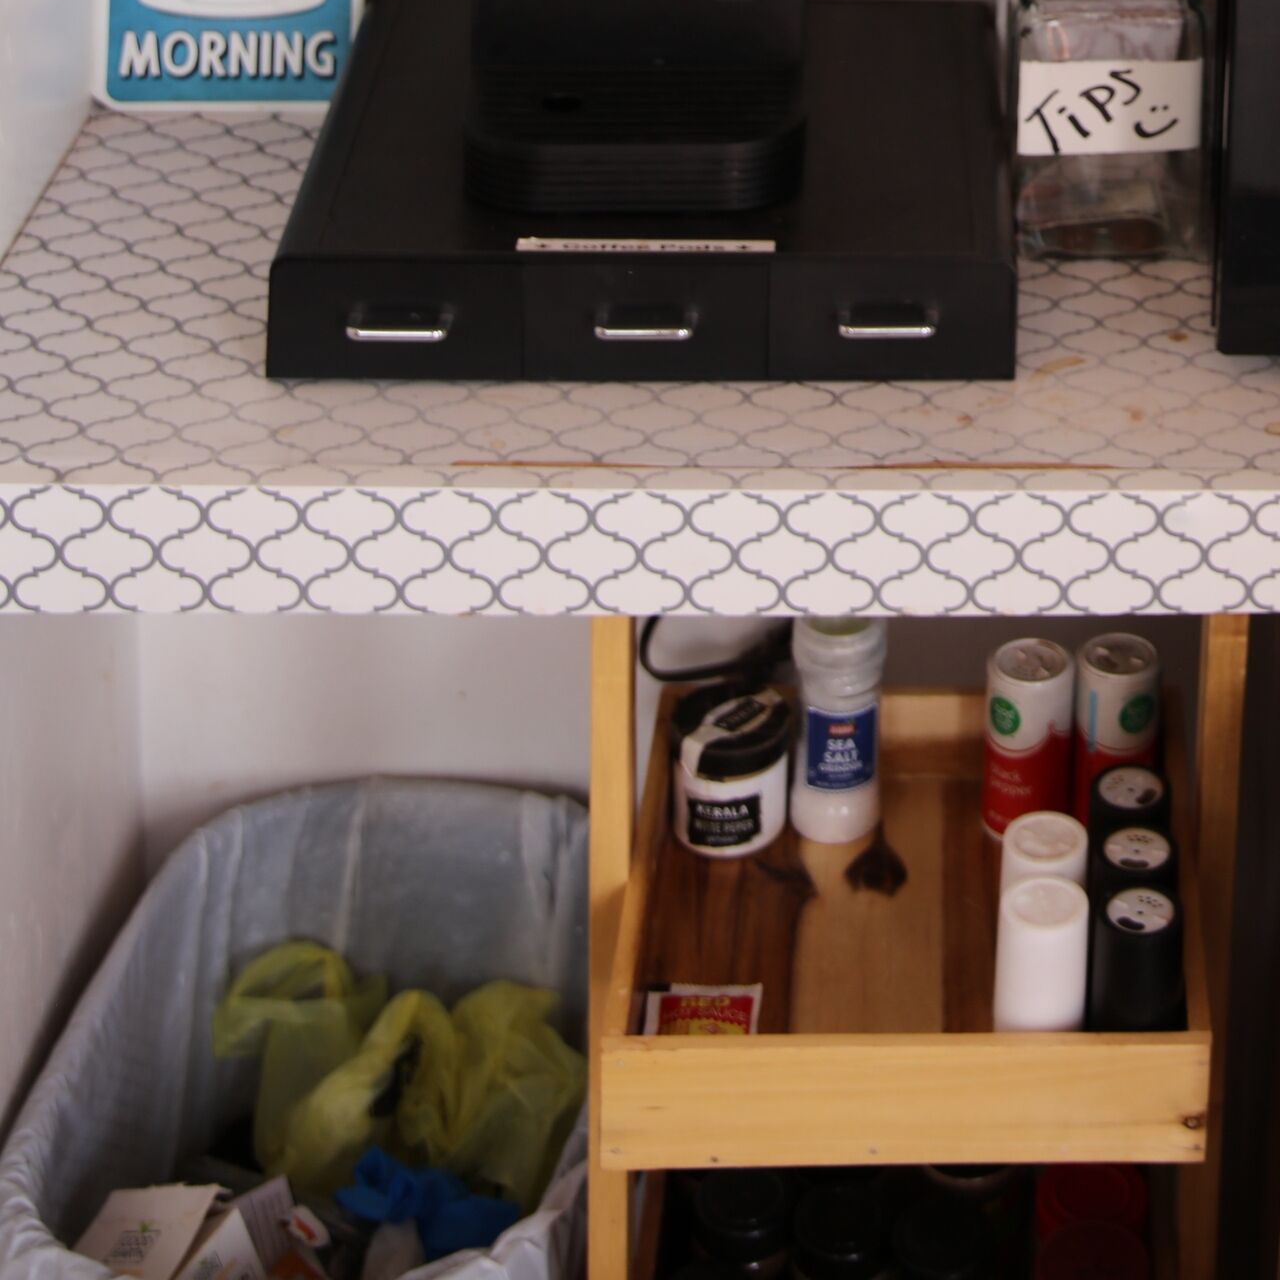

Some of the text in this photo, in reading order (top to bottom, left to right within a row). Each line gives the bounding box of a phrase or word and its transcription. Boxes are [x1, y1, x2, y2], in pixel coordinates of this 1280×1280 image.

[118, 28, 337, 82] MORNING
[827, 738, 856, 751] SEA
[824, 751, 860, 764] SALT
